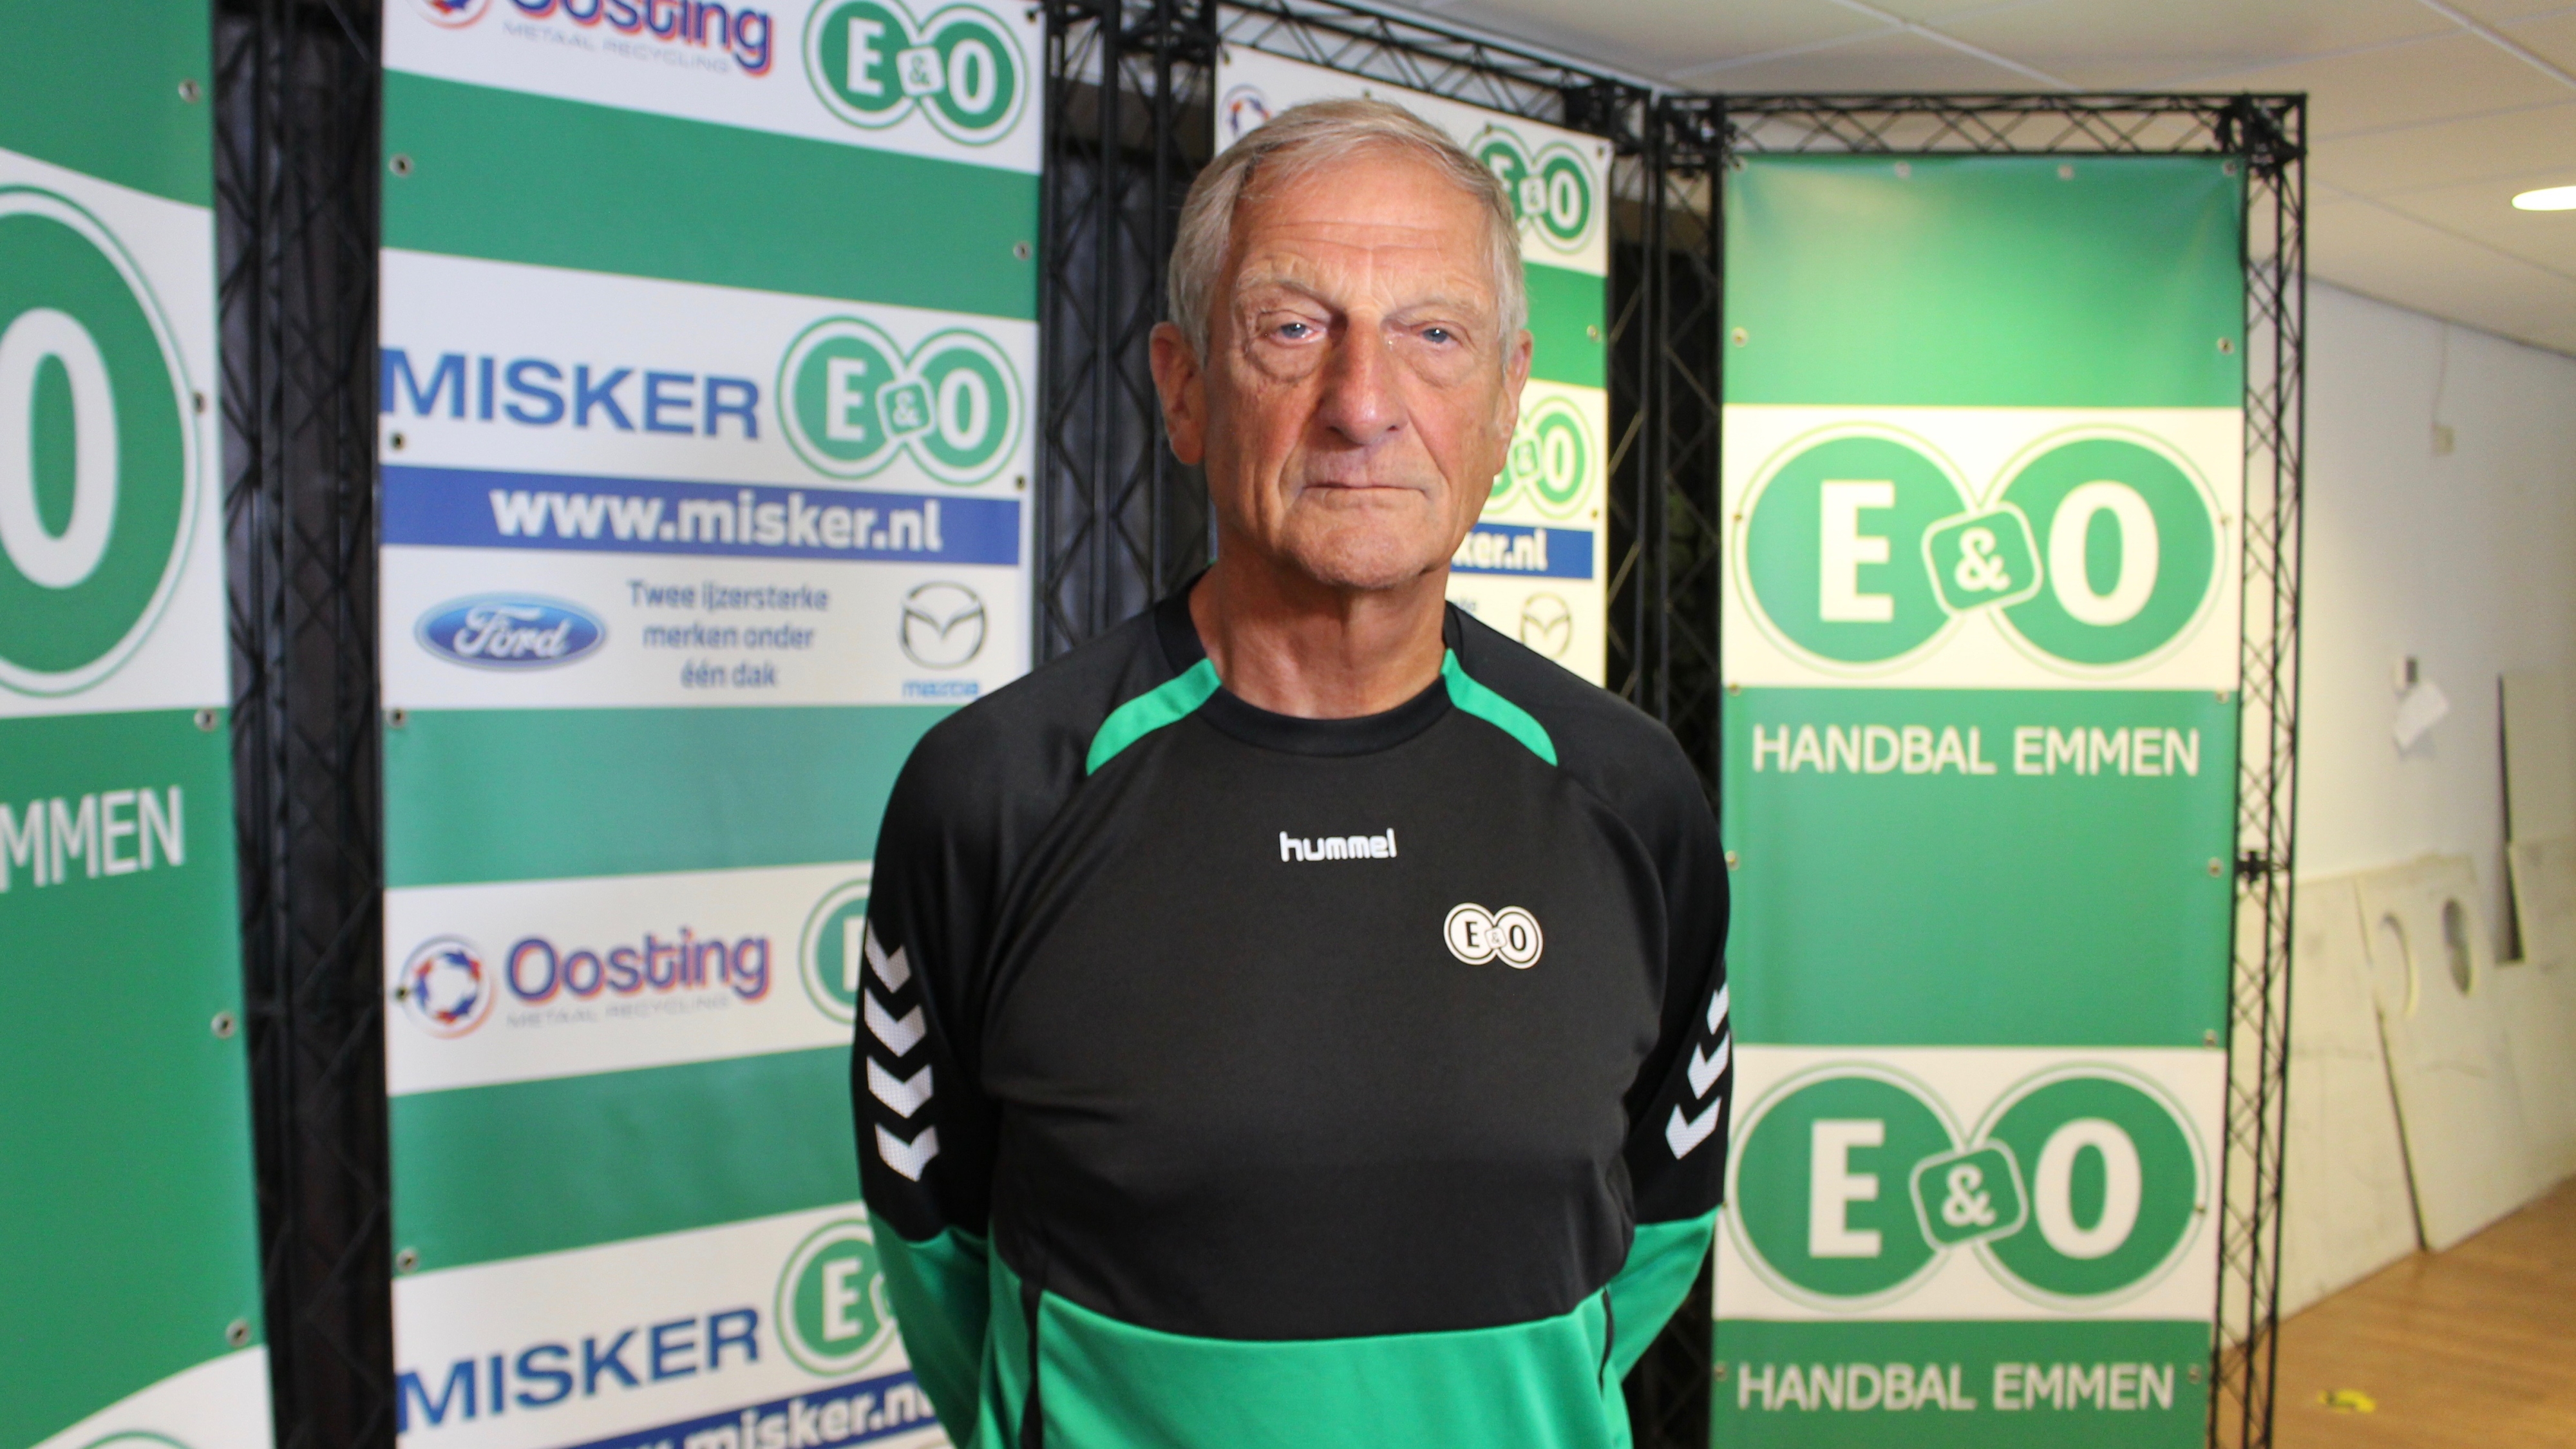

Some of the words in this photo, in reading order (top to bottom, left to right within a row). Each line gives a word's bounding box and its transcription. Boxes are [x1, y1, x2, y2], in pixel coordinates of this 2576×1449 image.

[506, 0, 774, 77] osting
[380, 347, 761, 440] MISKER
[490, 488, 943, 552] www.misker.nl
[1820, 479, 2159, 625] E&O
[627, 579, 695, 607] Twee
[452, 603, 571, 659] Ford
[643, 621, 737, 649] merken
[743, 621, 814, 649] onder
[680, 658, 726, 688] één
[731, 658, 777, 688] dak
[1752, 724, 1998, 775] HANDBAL
[2014, 725, 2200, 777] EMMEN
[0, 784, 184, 894] MMEN
[1279, 828, 1397, 862] hummel
[506, 926, 772, 1003] Oosting
[1465, 921, 1527, 952] E&O
[1808, 1117, 2142, 1259] E&O
[397, 1306, 761, 1435] MISKER
[1738, 1362, 1977, 1412] HANDBAL
[1992, 1363, 2174, 1411] EMMEN
